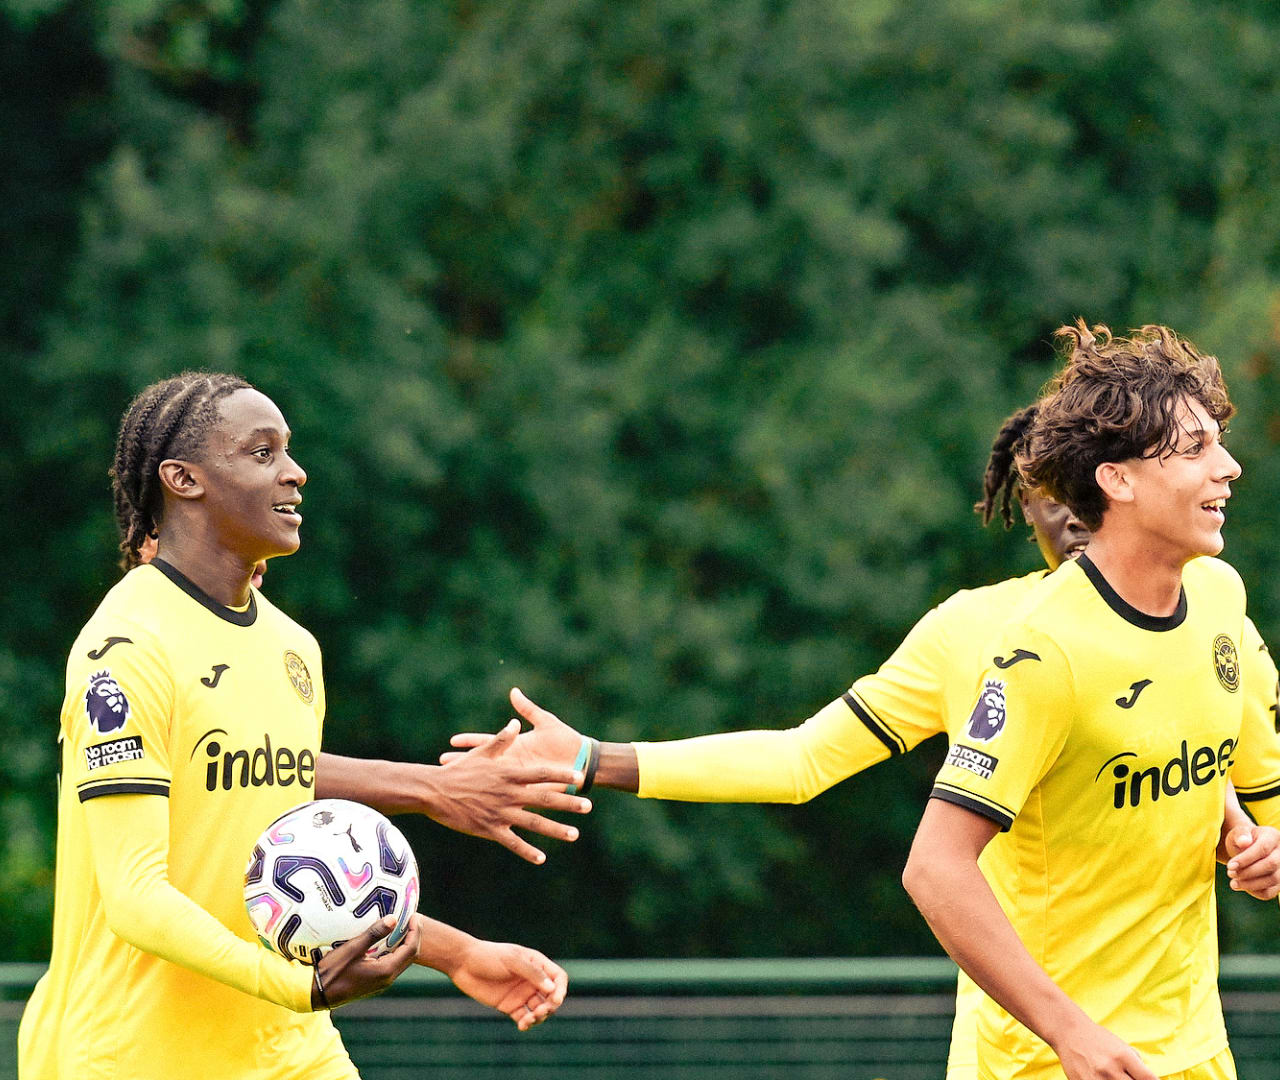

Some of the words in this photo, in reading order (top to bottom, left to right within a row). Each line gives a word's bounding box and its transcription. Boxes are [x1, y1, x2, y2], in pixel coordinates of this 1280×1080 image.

[85, 747, 101, 760] No
[101, 739, 137, 755] room
[103, 749, 144, 766] racism
[191, 729, 315, 791] indee
[960, 748, 992, 768] room
[956, 758, 993, 780] racism
[1095, 736, 1239, 809] indee
